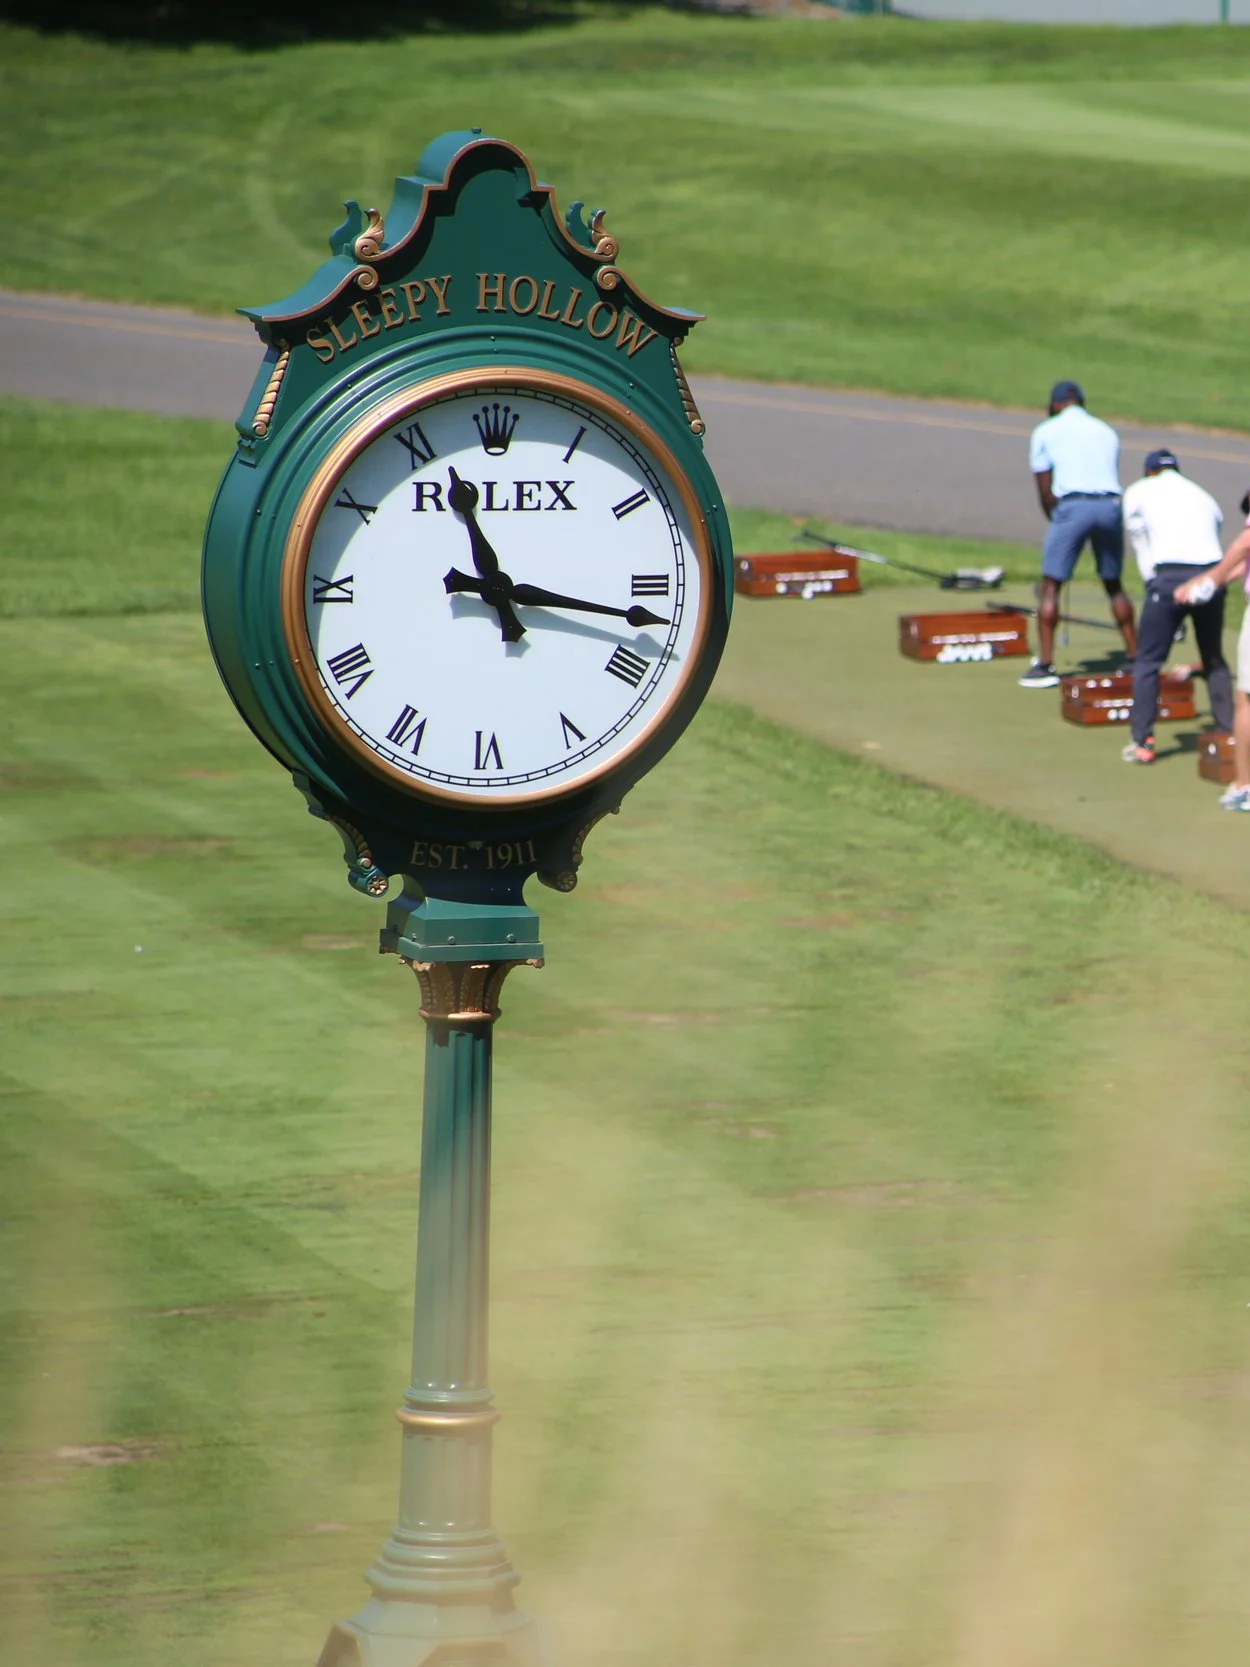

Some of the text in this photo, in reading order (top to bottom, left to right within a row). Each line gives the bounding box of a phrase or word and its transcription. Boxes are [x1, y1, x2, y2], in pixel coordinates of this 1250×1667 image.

[306, 273, 659, 363] SLEEPY HOLLOW
[394, 422, 437, 470] XI
[334, 488, 378, 525] X
[412, 481, 577, 511] RLEX
[611, 488, 650, 520] II
[313, 574, 353, 604] IX
[631, 573, 669, 597] III
[326, 642, 375, 700] VIII
[604, 644, 651, 689] IIII
[385, 704, 427, 756] VII
[559, 711, 586, 750] V
[474, 731, 504, 770] VI
[410, 839, 538, 870] EST. 1911
